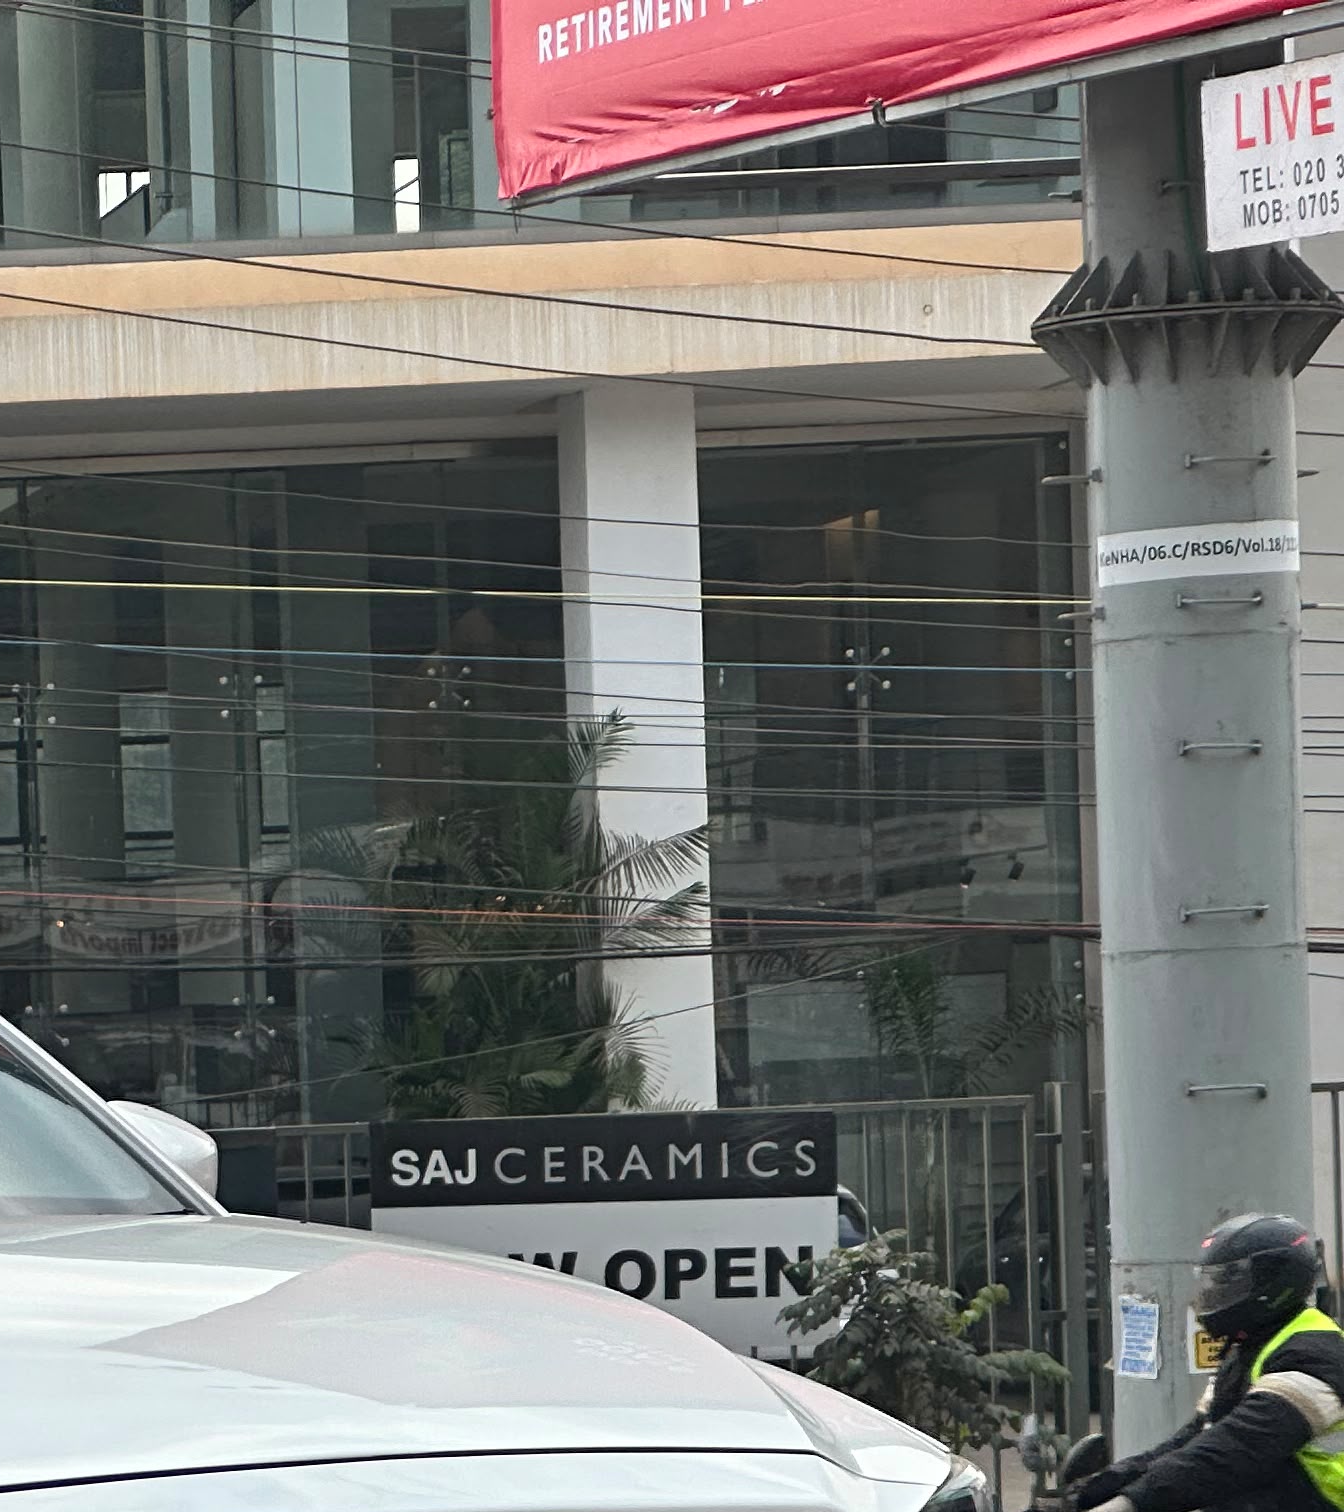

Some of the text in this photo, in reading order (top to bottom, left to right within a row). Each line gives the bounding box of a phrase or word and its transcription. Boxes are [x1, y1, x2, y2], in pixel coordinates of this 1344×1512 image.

[1234, 74, 1335, 150] LIVE
[1239, 166, 1284, 194] TEL:
[1293, 157, 1326, 187] 020
[1243, 190, 1340, 228] MOB: 0705
[390, 1140, 817, 1187] SAJ CERAMICS
[604, 1245, 813, 1301] OPEN
